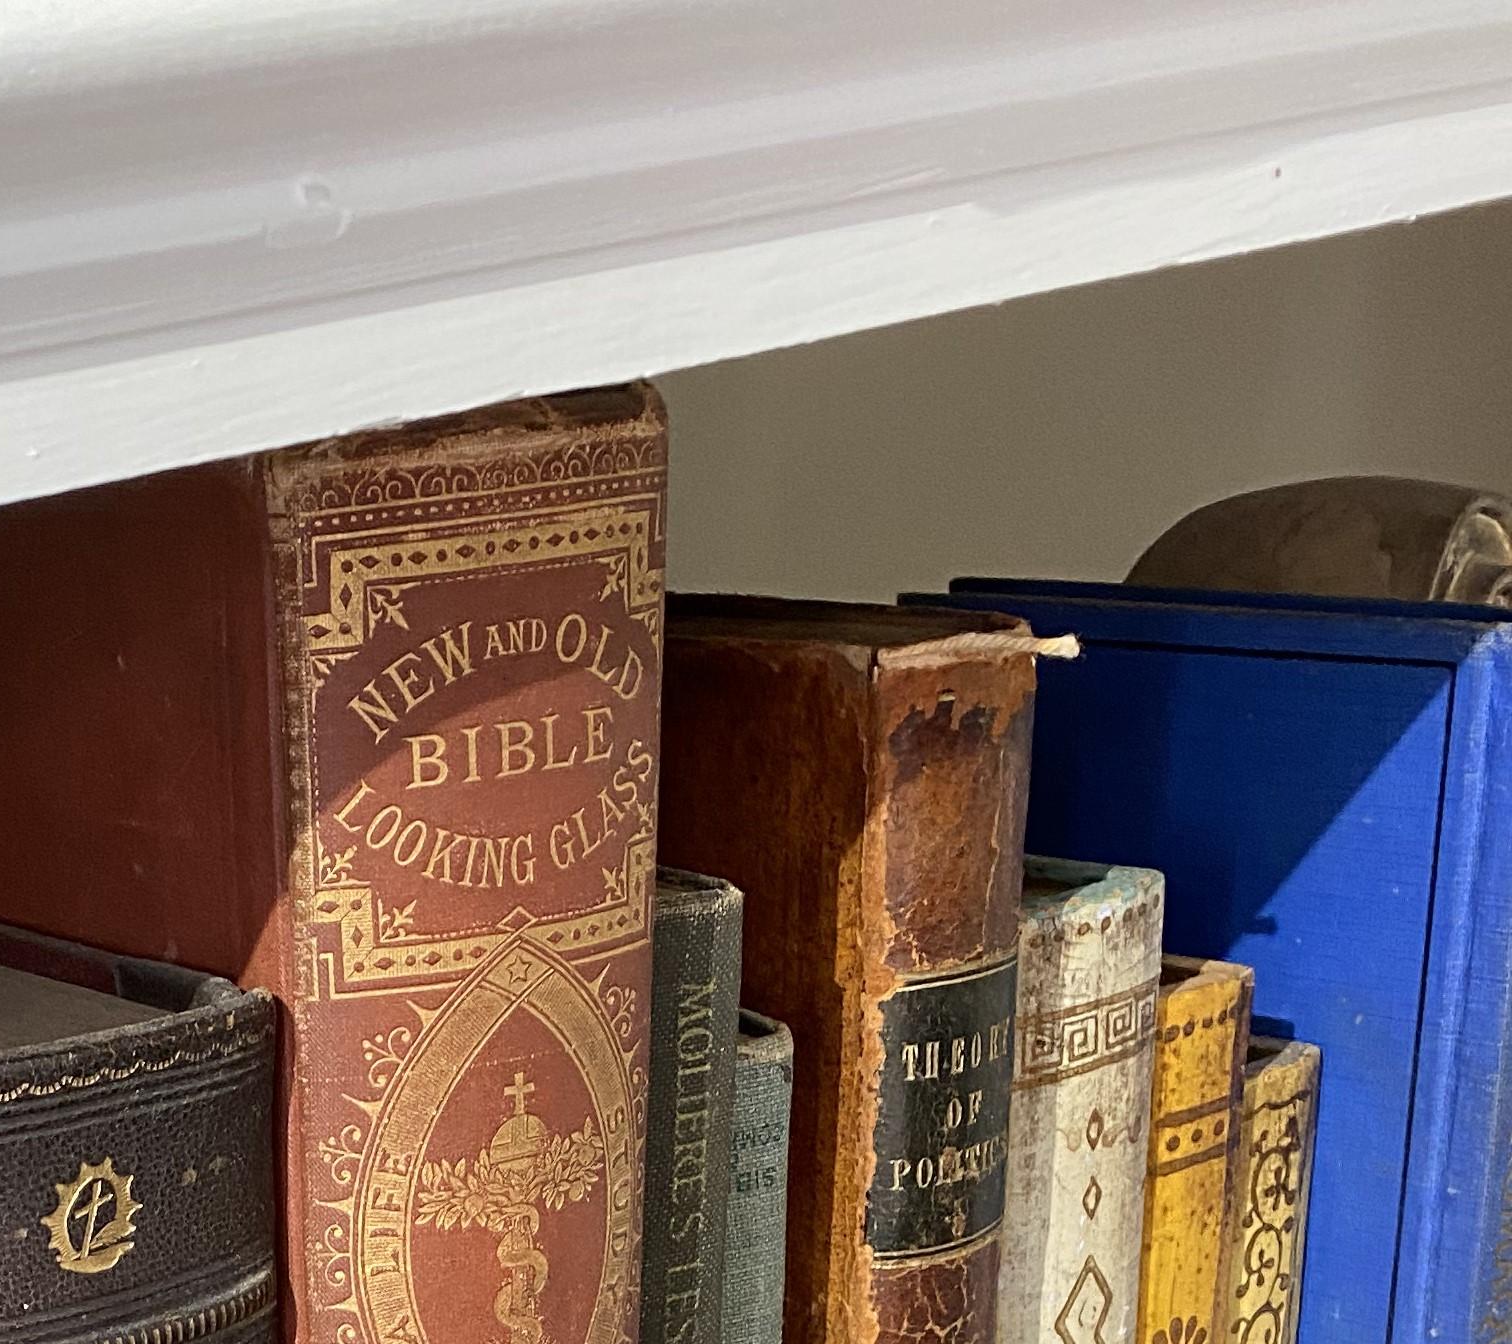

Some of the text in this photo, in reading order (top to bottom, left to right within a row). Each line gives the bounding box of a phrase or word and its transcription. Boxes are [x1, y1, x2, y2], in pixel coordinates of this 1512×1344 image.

[347, 613, 644, 745] NEW AND OLD
[401, 703, 614, 790] BIBLE
[333, 738, 654, 888] LOOKING GLASS
[901, 1016, 1011, 1082] THEORY
[947, 1089, 983, 1131] OF
[370, 1147, 413, 1280] LIFE
[601, 1104, 627, 1308] STUDY
